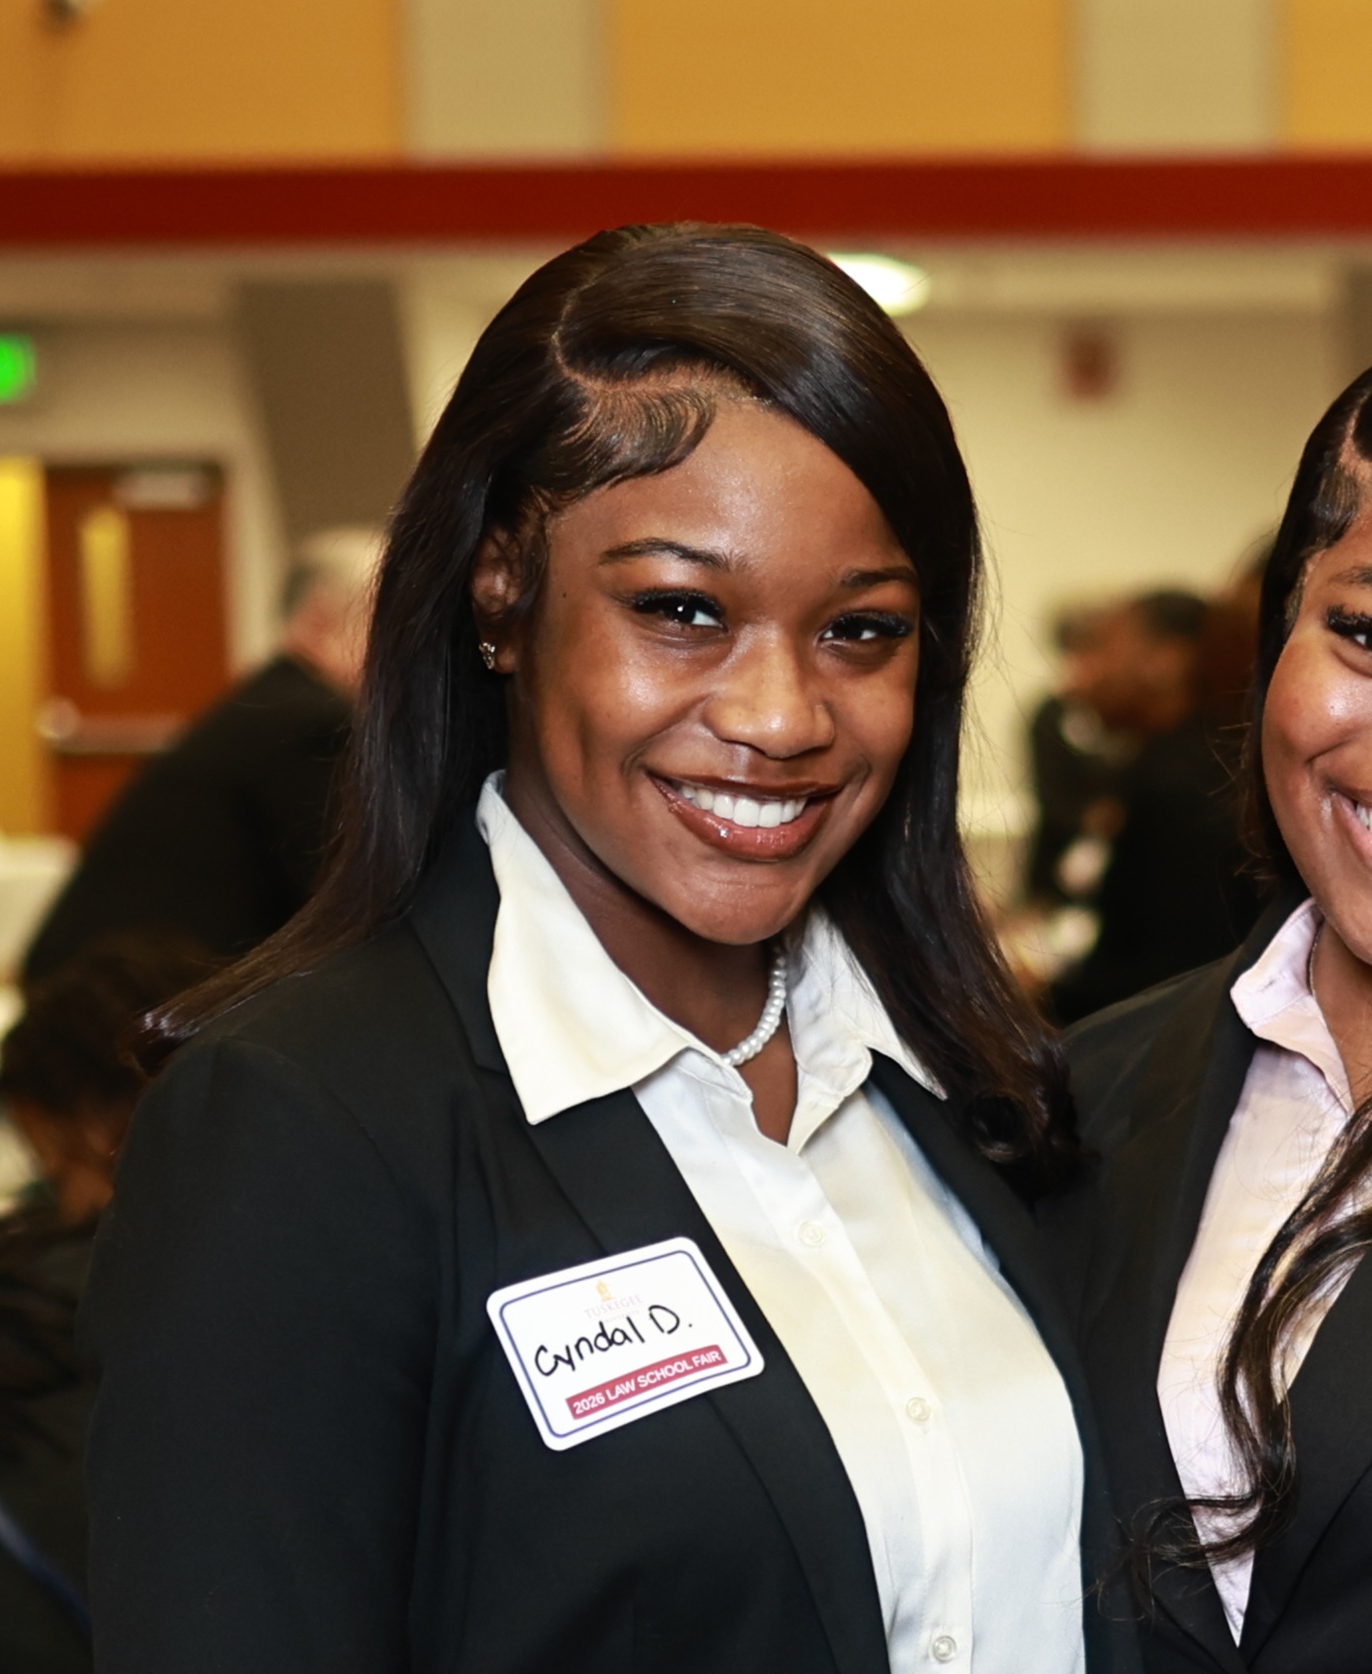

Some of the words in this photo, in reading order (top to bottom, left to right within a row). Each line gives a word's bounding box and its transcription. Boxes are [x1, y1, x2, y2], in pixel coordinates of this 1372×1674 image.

[534, 1316, 645, 1376] Cyndal
[648, 1304, 693, 1335] D.
[573, 1393, 605, 1414] 2026
[606, 1380, 636, 1400] LAW
[637, 1360, 693, 1387] SCHOOL
[691, 1351, 722, 1368] FAIR
